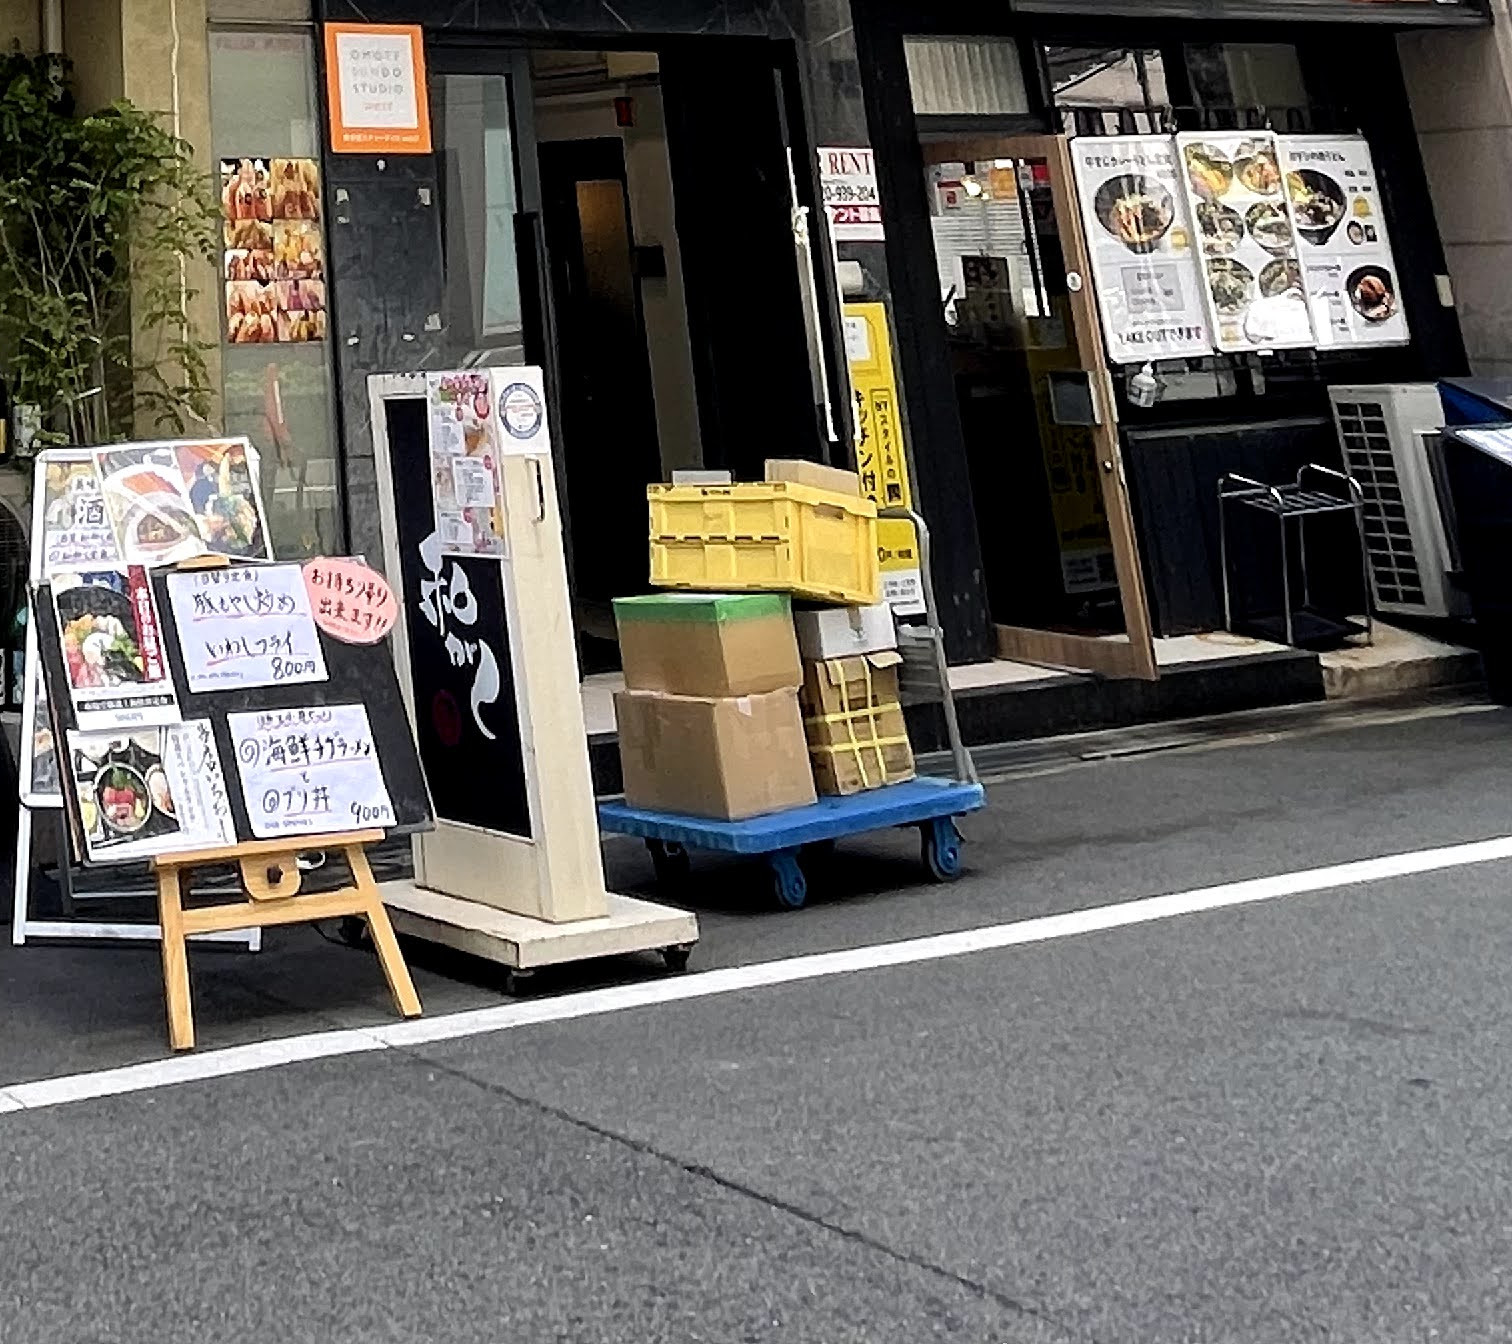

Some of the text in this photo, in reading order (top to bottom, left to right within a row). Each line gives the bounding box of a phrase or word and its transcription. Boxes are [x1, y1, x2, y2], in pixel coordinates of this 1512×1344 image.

[829, 152, 871, 175] RENT
[205, 630, 293, 659] いわしフライ
[271, 656, 316, 680] 800円
